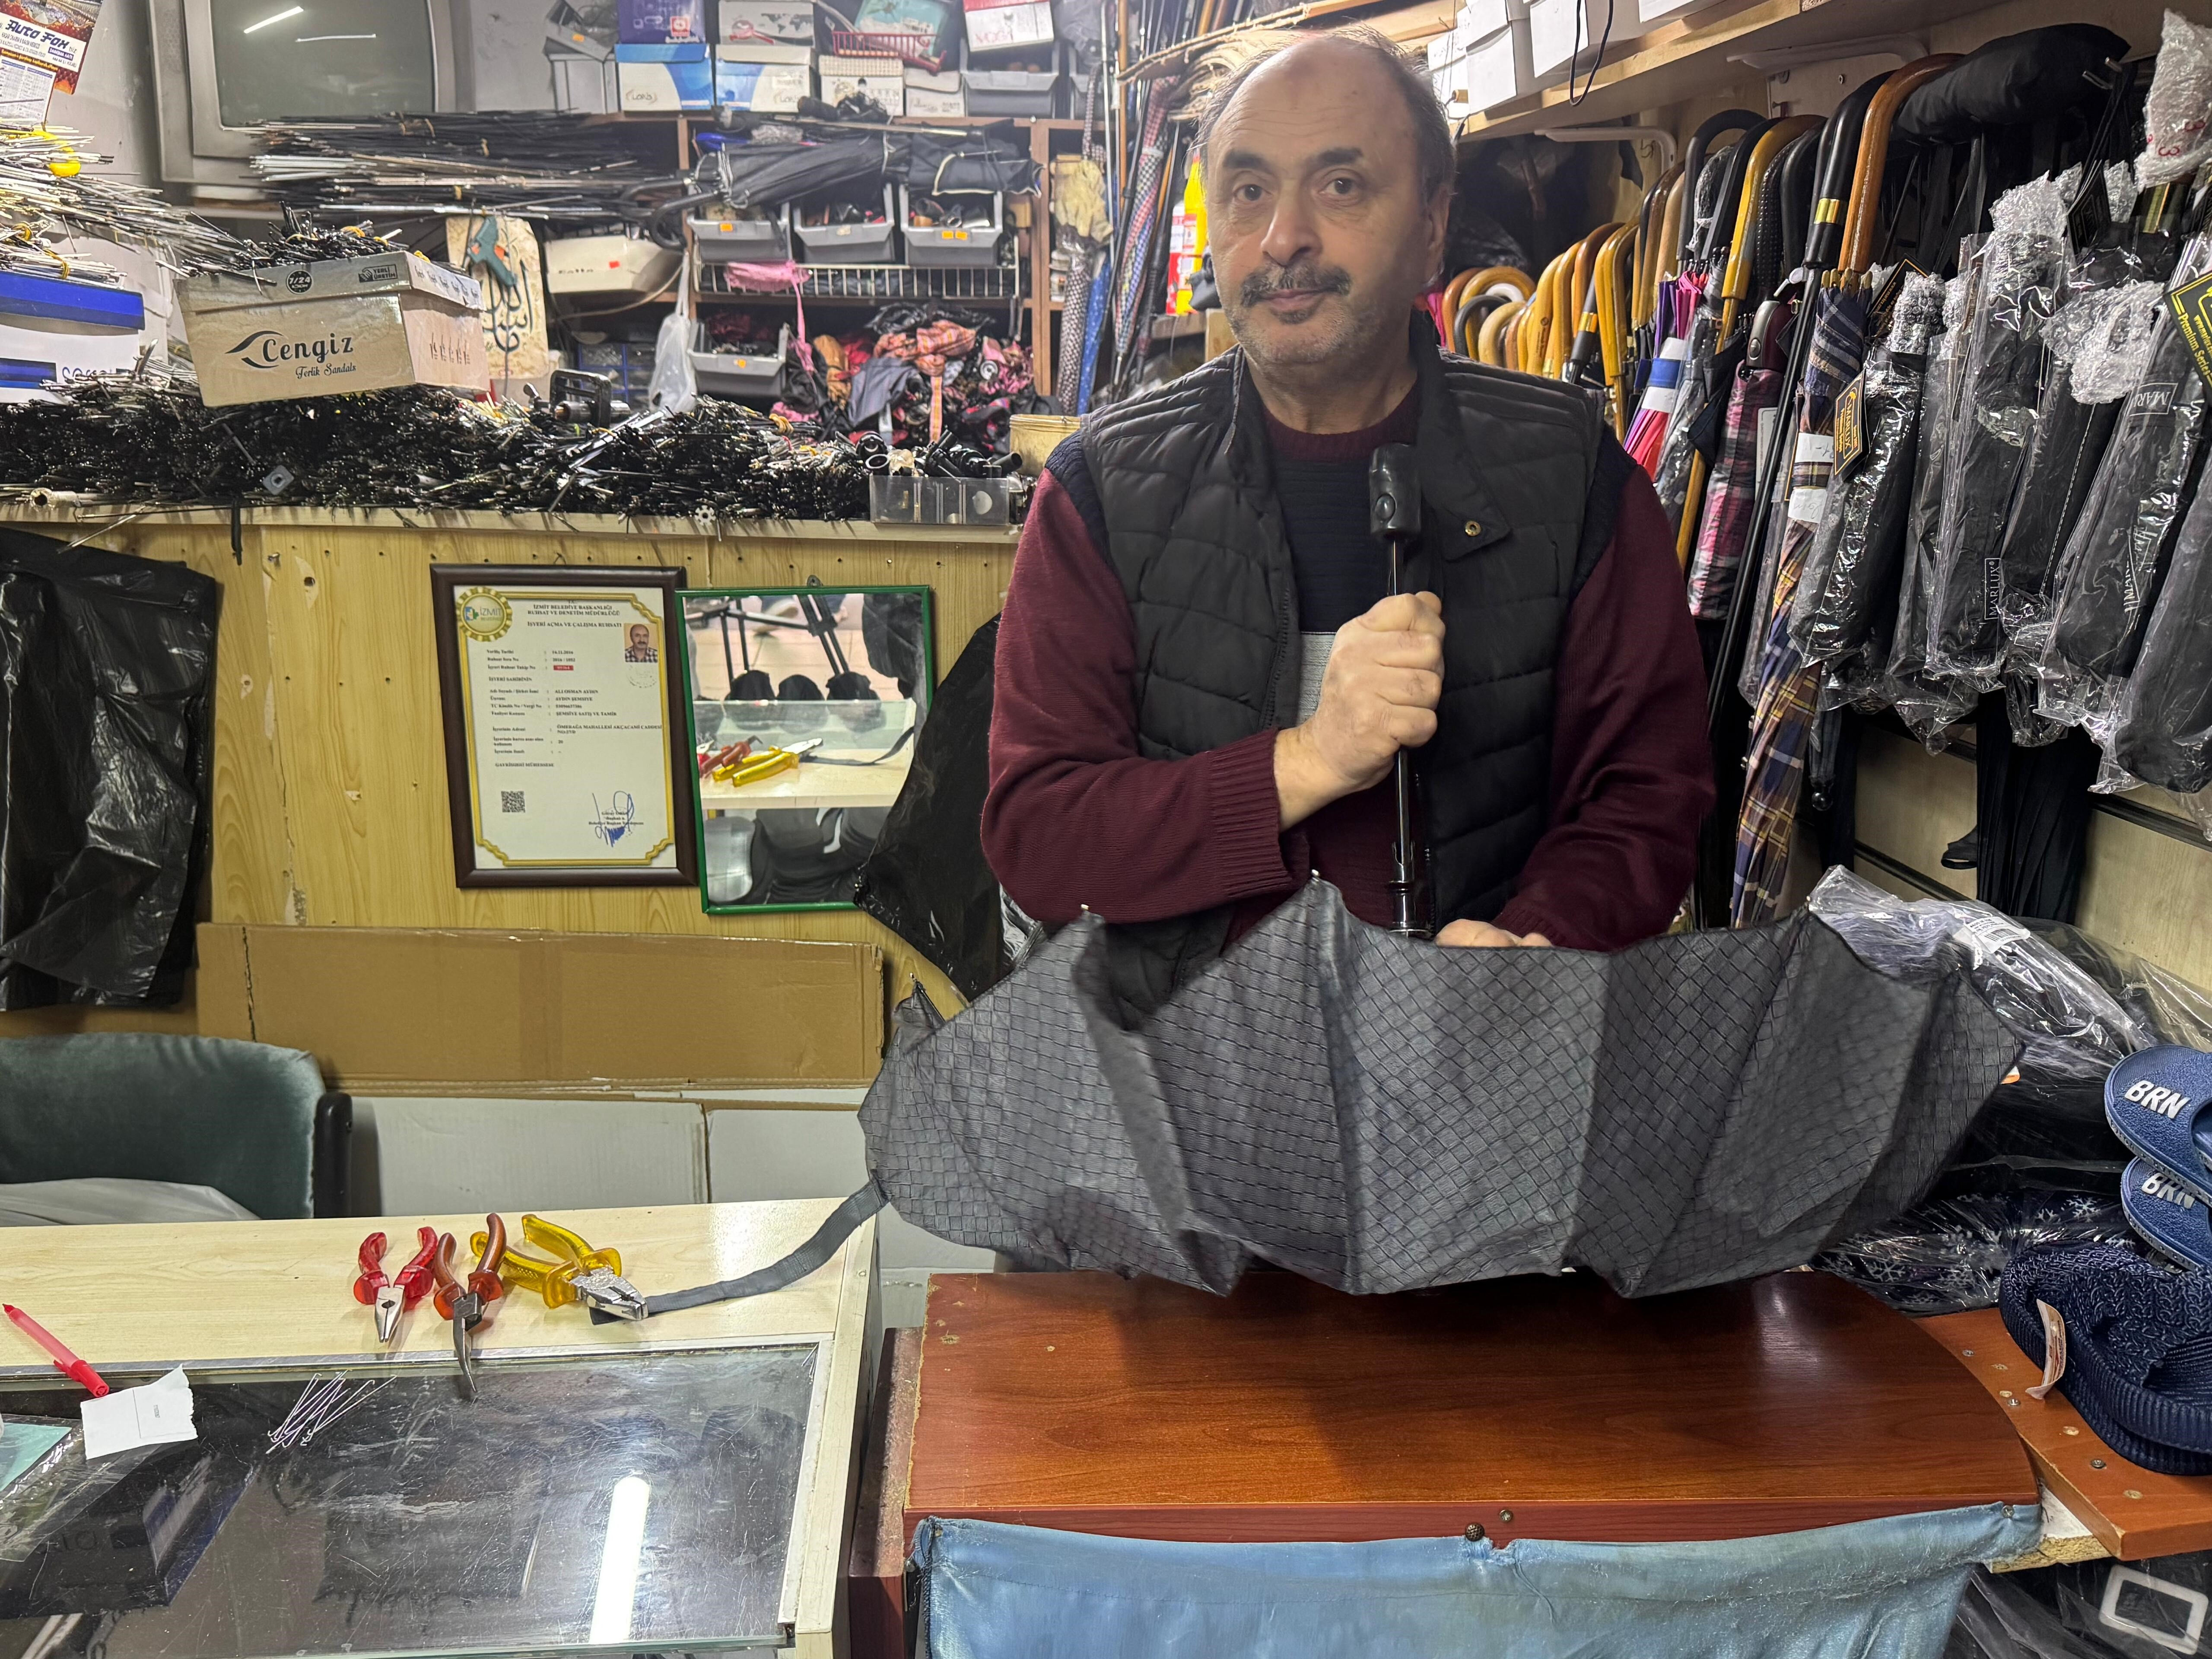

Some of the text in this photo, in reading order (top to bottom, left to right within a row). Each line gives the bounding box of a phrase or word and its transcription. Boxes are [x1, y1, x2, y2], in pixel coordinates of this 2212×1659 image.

[5, 19, 41, 39] Auto
[40, 32, 70, 49] Fox
[263, 333, 354, 363] Cengiz
[2178, 312, 2211, 376] Premium Series
[296, 362, 356, 379] Terlik Sandals
[2124, 1080, 2191, 1119] BRN
